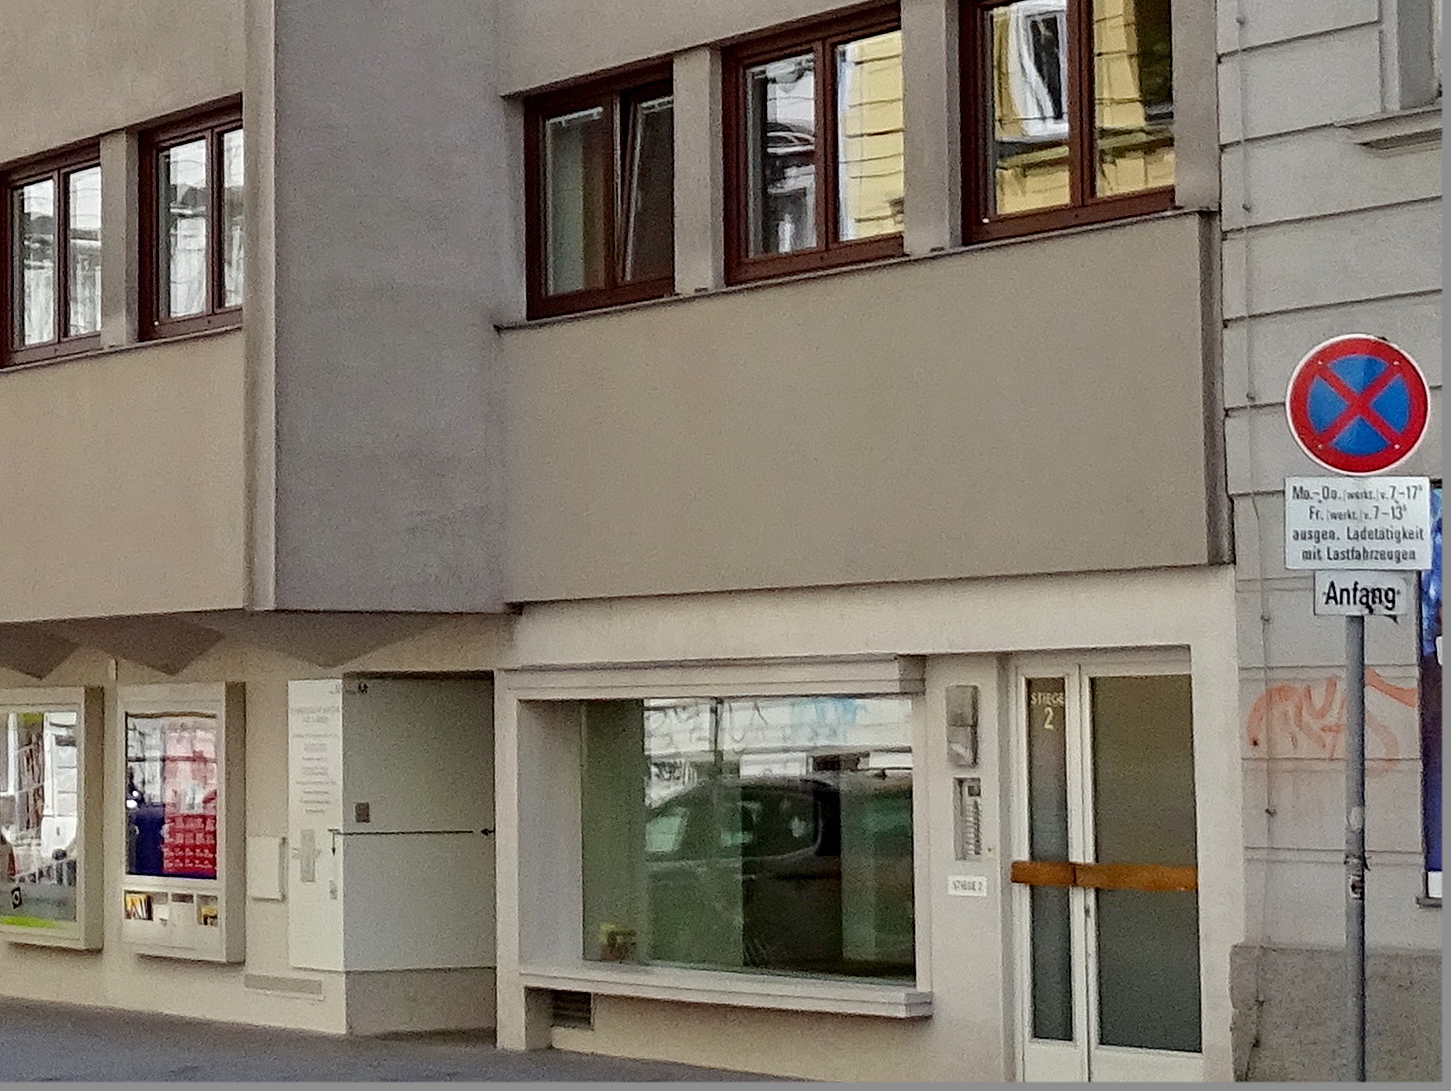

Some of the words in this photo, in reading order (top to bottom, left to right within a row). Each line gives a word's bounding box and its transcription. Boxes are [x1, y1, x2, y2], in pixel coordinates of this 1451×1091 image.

[1308, 505, 1324, 521] Fr.
[1292, 529, 1340, 544] ausgen.
[1301, 545, 1322, 561] mit
[1326, 546, 1417, 564] Lastfahrzeugen
[1324, 580, 1396, 611] Anfang
[1030, 692, 1064, 708] STIEGE
[1044, 707, 1054, 730] 2
